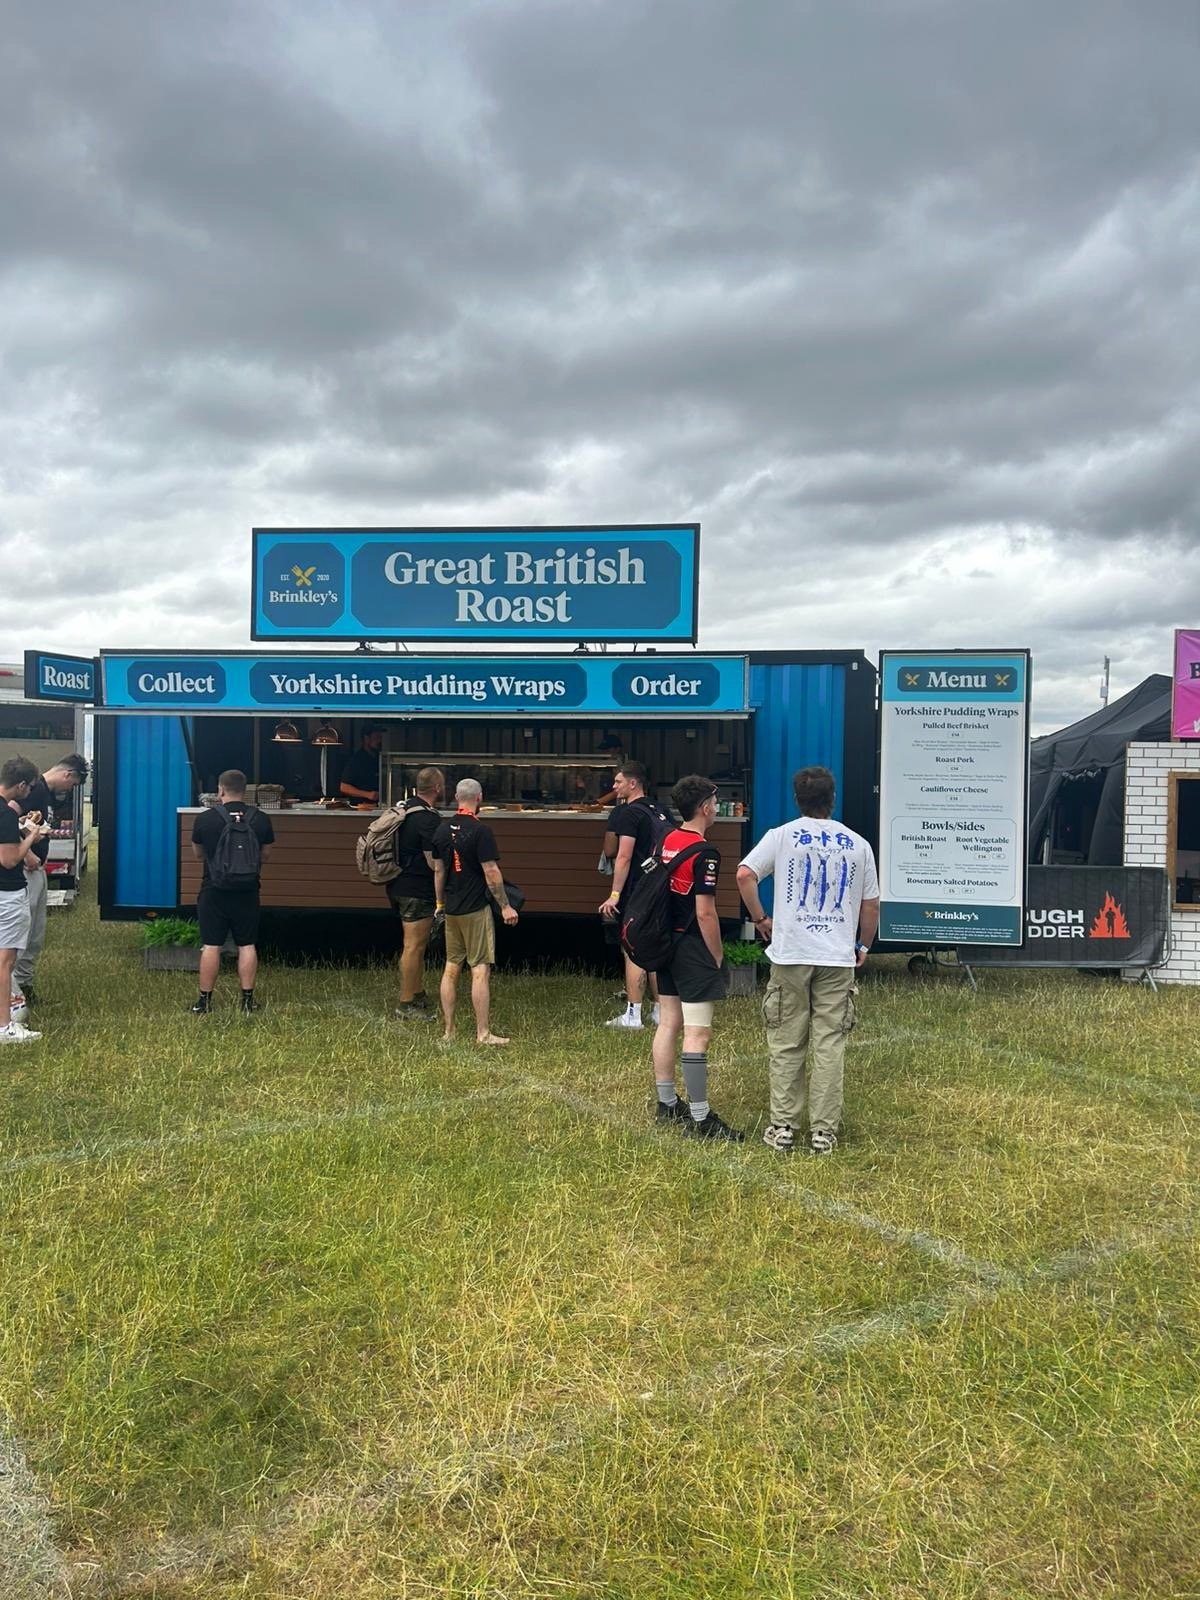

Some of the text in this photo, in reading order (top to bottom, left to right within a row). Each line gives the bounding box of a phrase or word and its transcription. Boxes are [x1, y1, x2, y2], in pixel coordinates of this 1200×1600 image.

[385, 547, 646, 585] Great British
[269, 590, 338, 605] Brinkley's
[455, 589, 572, 623] Roast
[43, 665, 91, 691] Roast
[138, 672, 216, 694] Collect
[631, 674, 702, 696] Order
[927, 671, 987, 688] Menu
[270, 673, 566, 701] Yorkshire Pudding Wraps
[895, 707, 1019, 718] Yorkshire Pudding Wraps
[963, 722, 989, 730] Brisket
[963, 786, 989, 794] Cheese
[921, 821, 986, 832] Bowls/Sides
[974, 837, 1010, 845] Vegetable
[962, 844, 1003, 853] Wellington
[907, 877, 999, 887] Rosemary Salted Potatoes
[934, 911, 979, 921] Brinkley's
[1026, 909, 1084, 924] UGH
[1028, 925, 1085, 938] DDER
